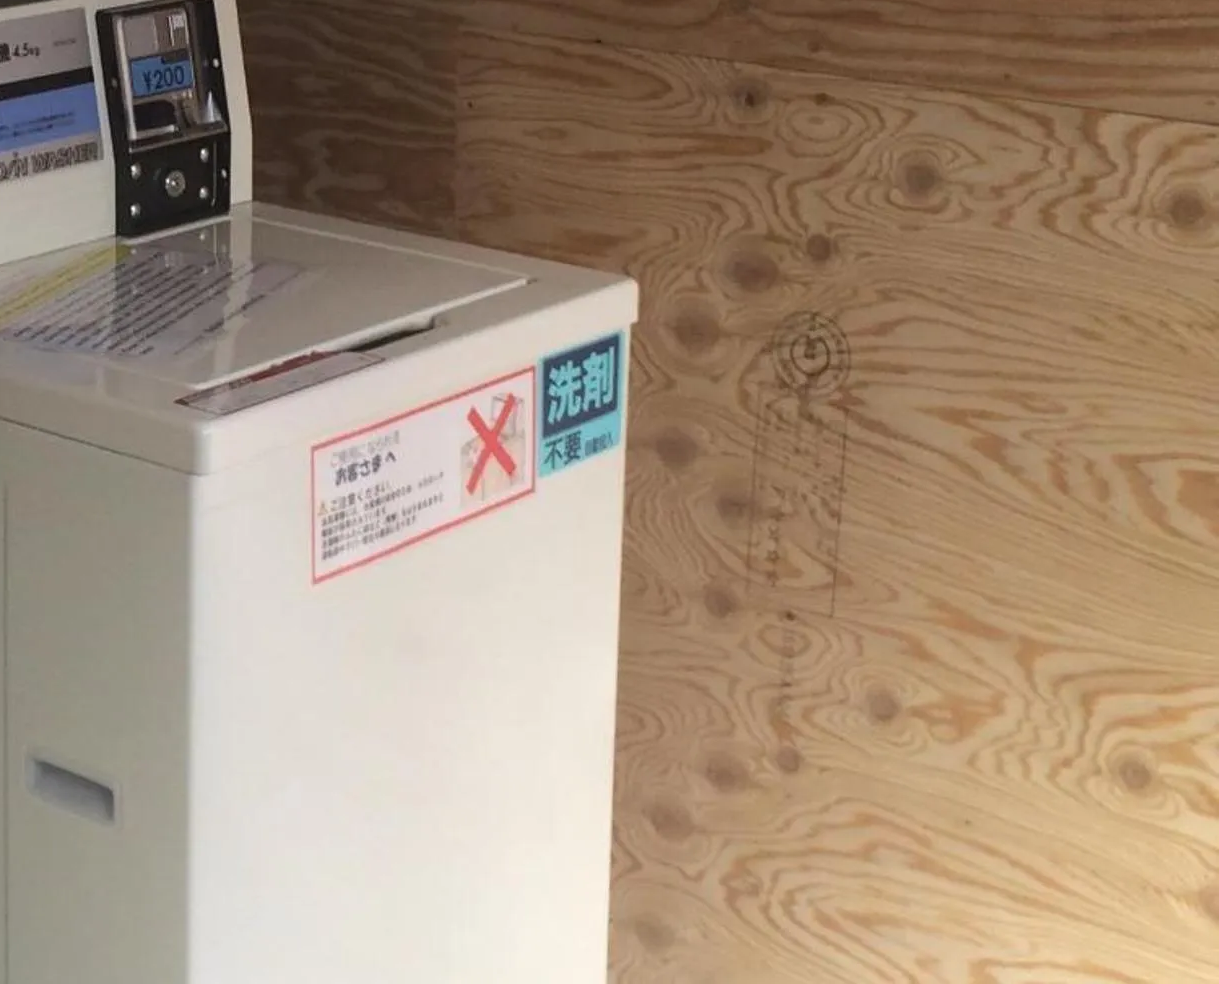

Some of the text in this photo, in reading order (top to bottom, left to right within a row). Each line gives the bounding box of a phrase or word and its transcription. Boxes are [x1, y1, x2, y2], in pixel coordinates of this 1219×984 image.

[143, 66, 185, 92] ¥200
[548, 346, 615, 425] 洗剤
[544, 430, 582, 470] 不要
